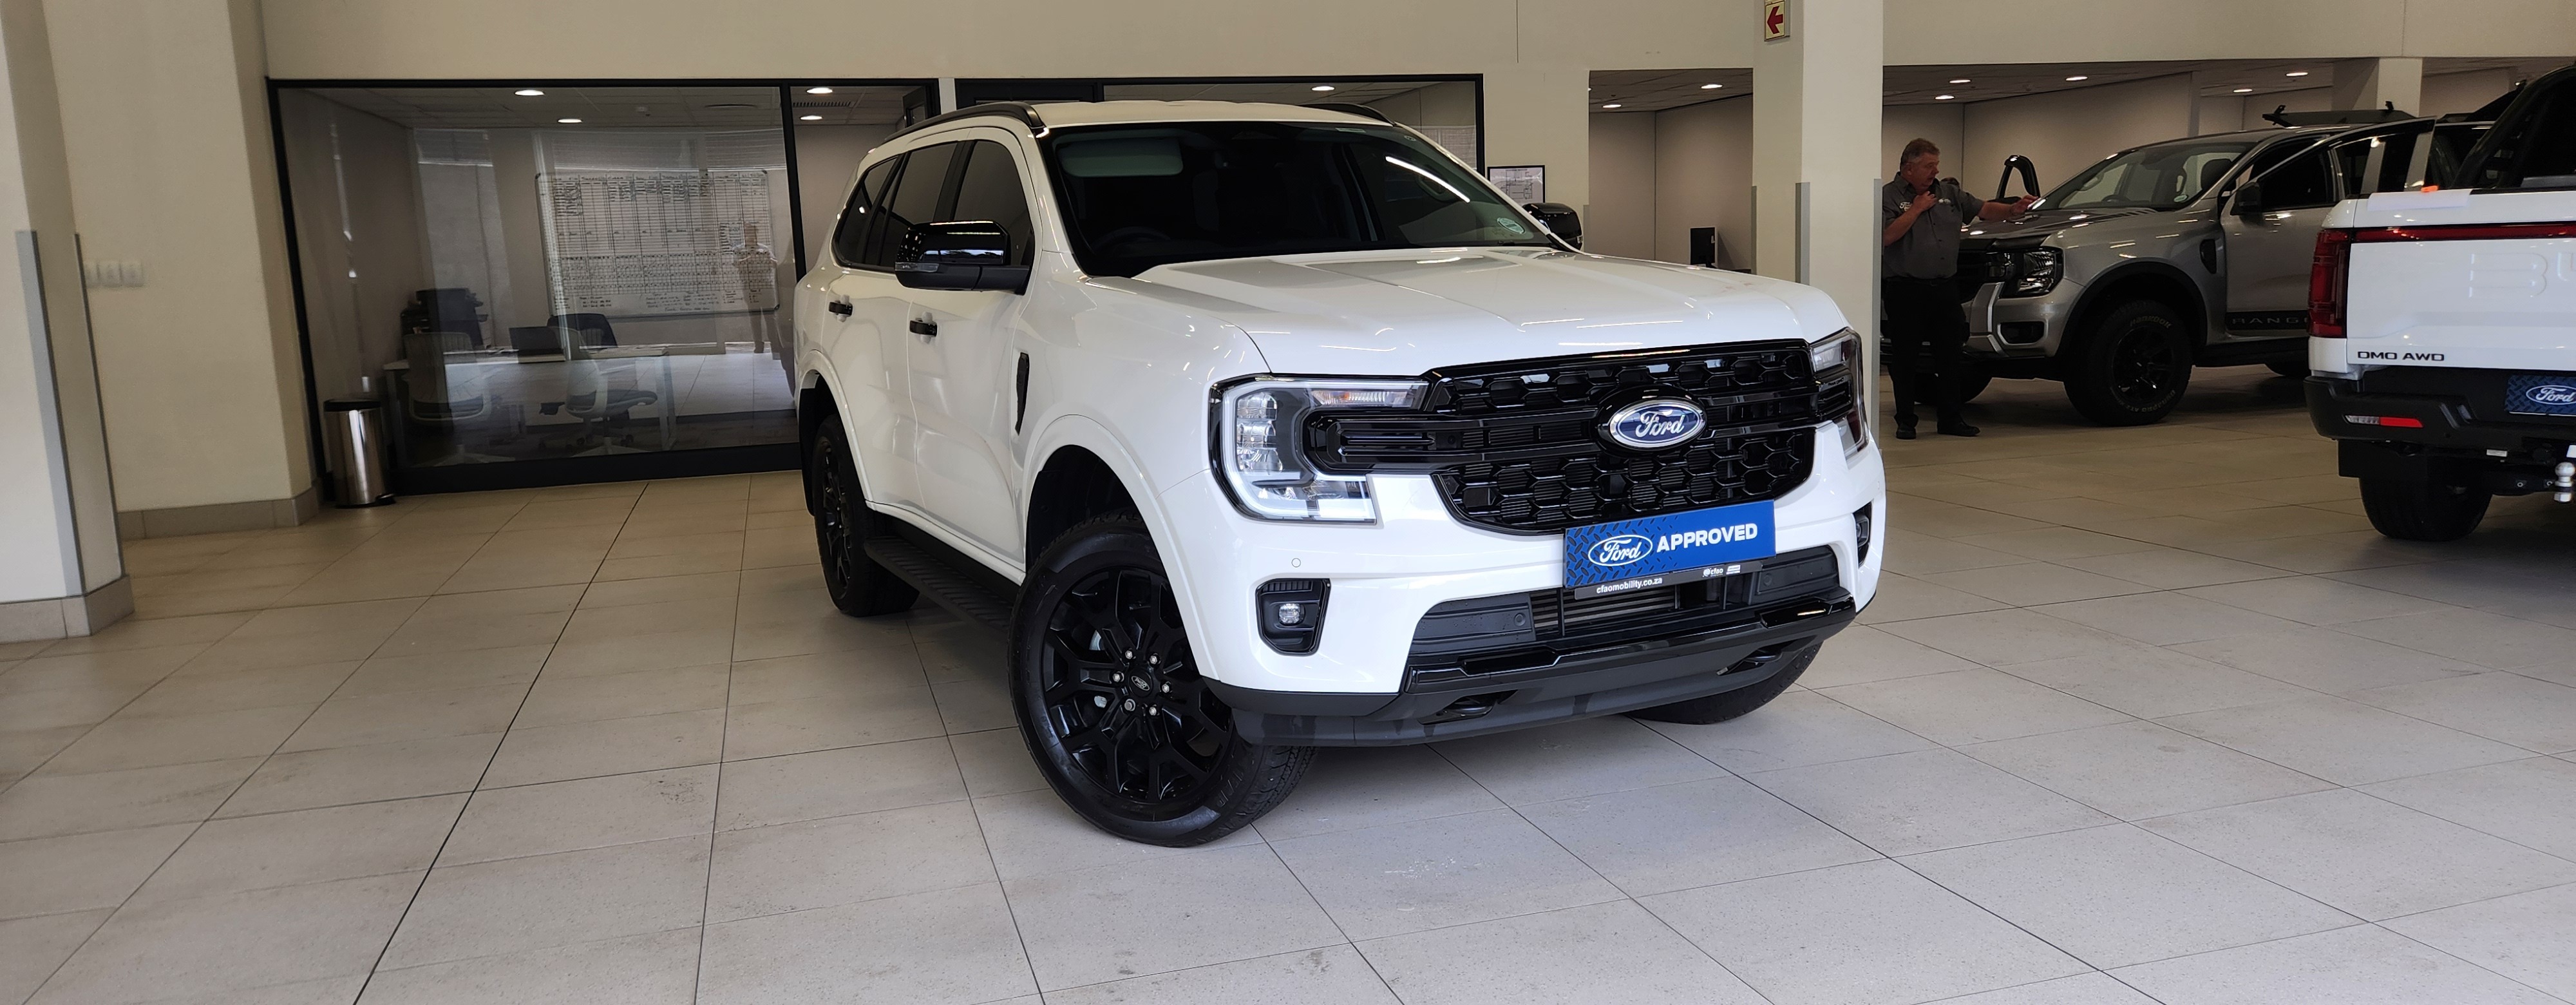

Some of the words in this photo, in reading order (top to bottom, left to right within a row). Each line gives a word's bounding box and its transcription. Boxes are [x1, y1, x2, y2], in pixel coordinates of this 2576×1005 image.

[2358, 351, 2398, 360] DMO
[2402, 352, 2445, 361] AWD
[2535, 386, 2576, 403] Ford
[1635, 409, 1685, 437] Ford
[1600, 538, 1642, 563] Ford
[1656, 522, 1758, 553] APPROVED
[1596, 576, 1663, 595] cfaomobility.co.za
